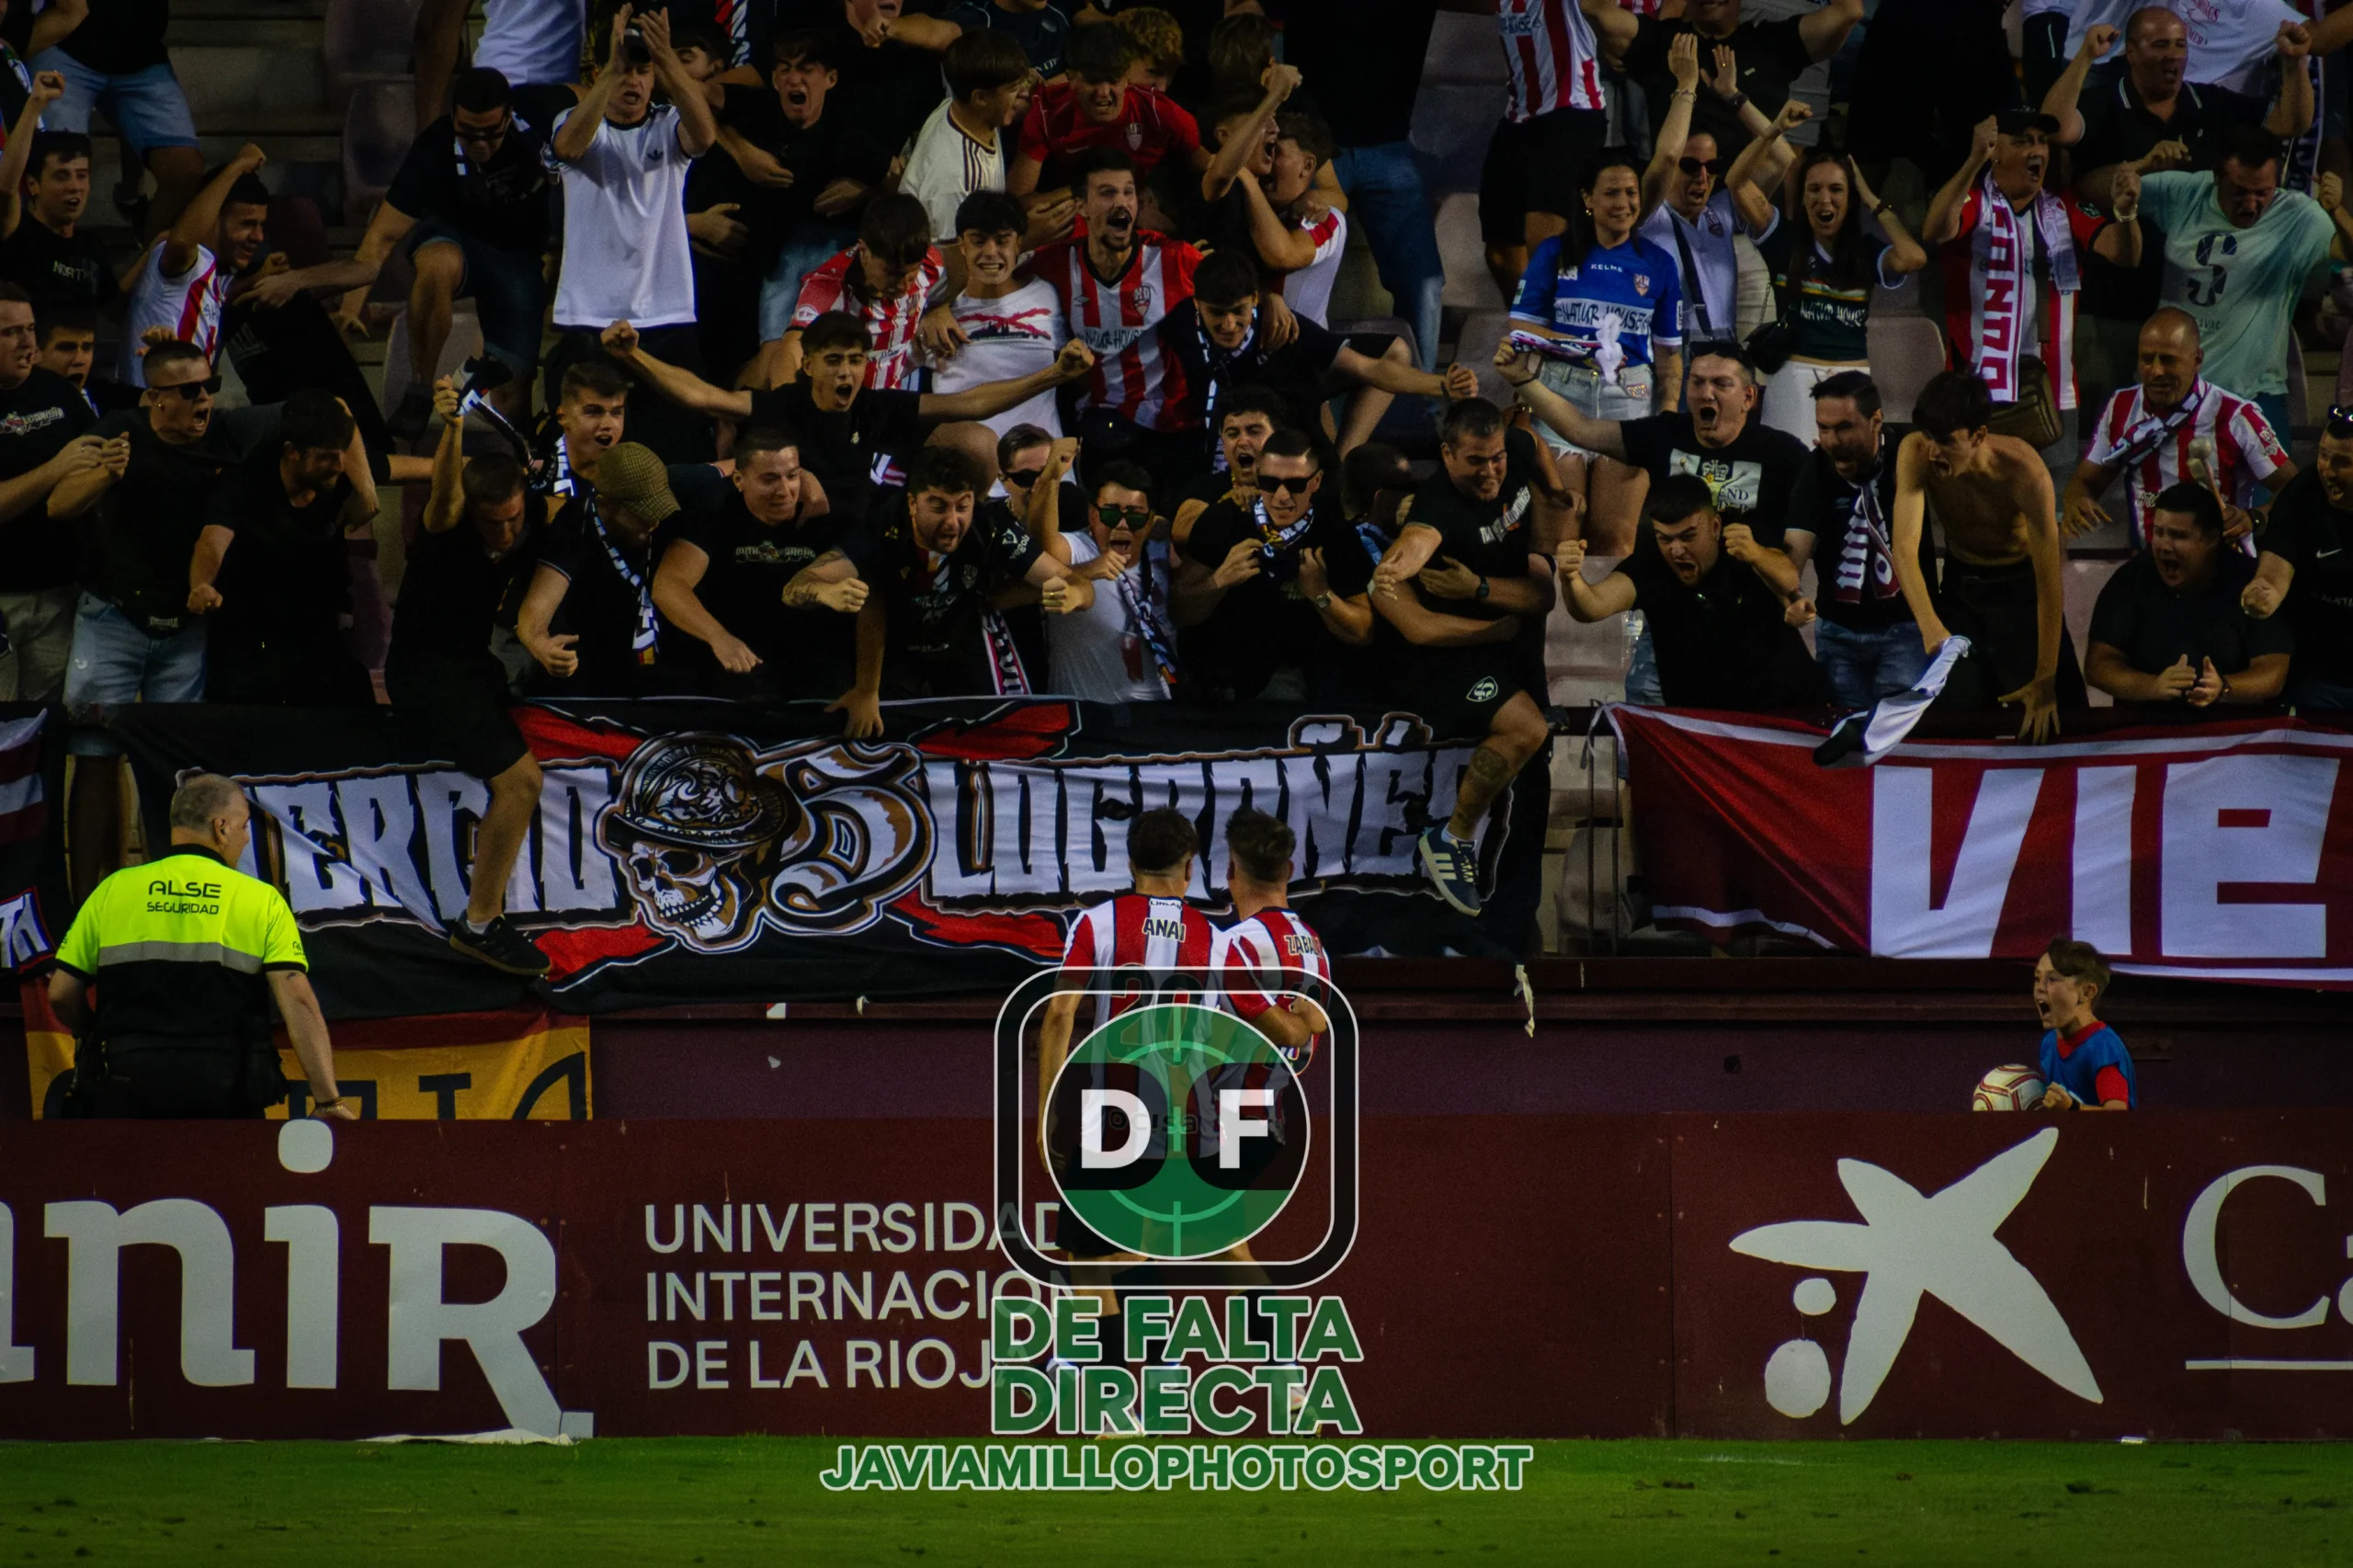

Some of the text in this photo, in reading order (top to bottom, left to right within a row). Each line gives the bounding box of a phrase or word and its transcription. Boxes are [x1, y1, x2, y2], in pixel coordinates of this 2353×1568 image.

[1590, 263, 1623, 274] KELME
[1560, 304, 1600, 326] NATUR
[235, 767, 619, 924] ERCIO
[1869, 754, 2340, 960] VIE
[148, 880, 222, 899] ALSE
[146, 901, 220, 915] SEGURIDAD
[647, 1341, 729, 1390] DE
[749, 1341, 828, 1390] LA
